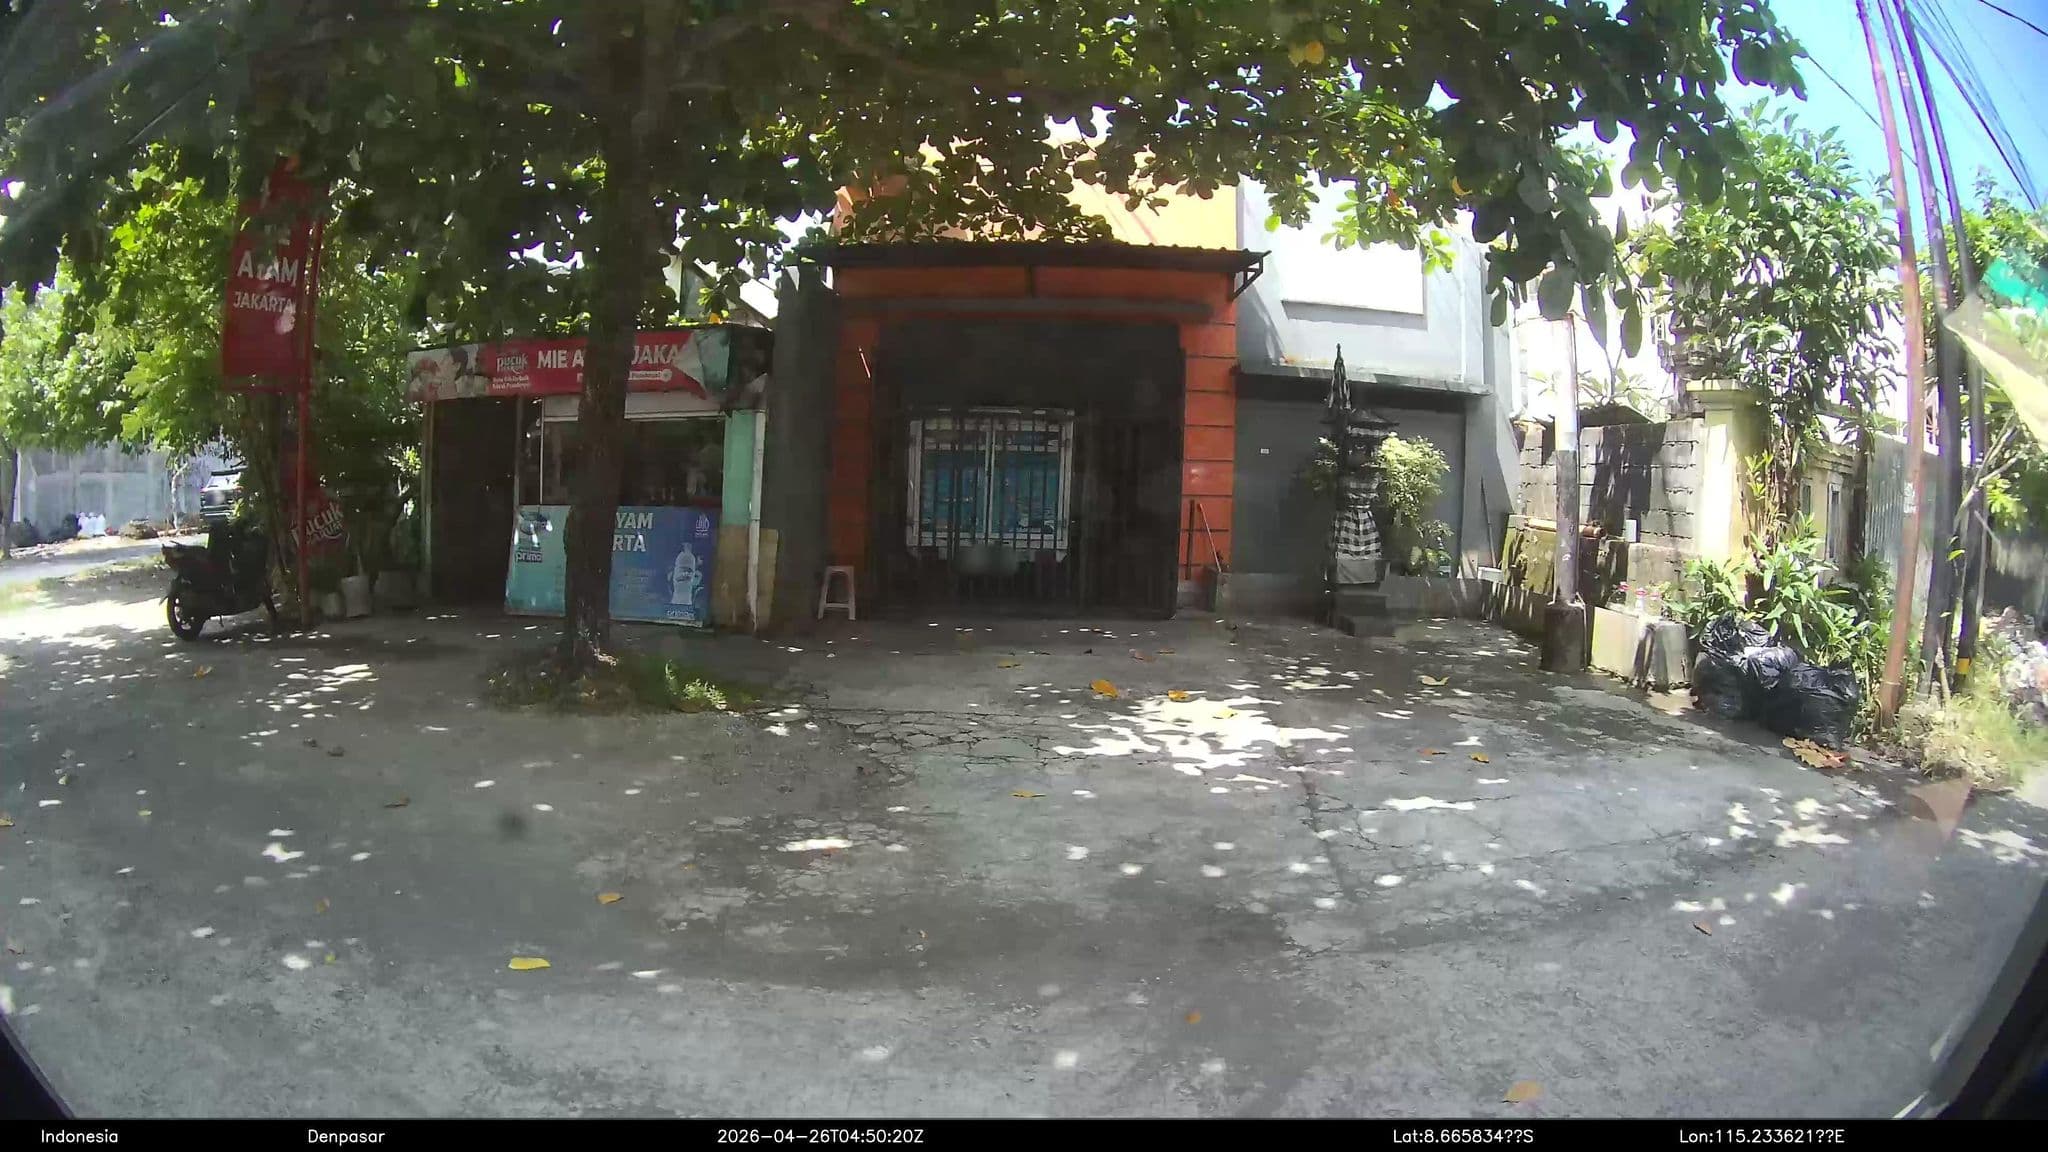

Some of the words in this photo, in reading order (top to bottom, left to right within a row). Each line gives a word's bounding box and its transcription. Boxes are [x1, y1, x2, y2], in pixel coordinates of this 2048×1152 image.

[536, 349, 569, 369] MIE
[631, 344, 682, 365] JAKA
[615, 511, 654, 530] YAM
[612, 533, 648, 552] RTA
